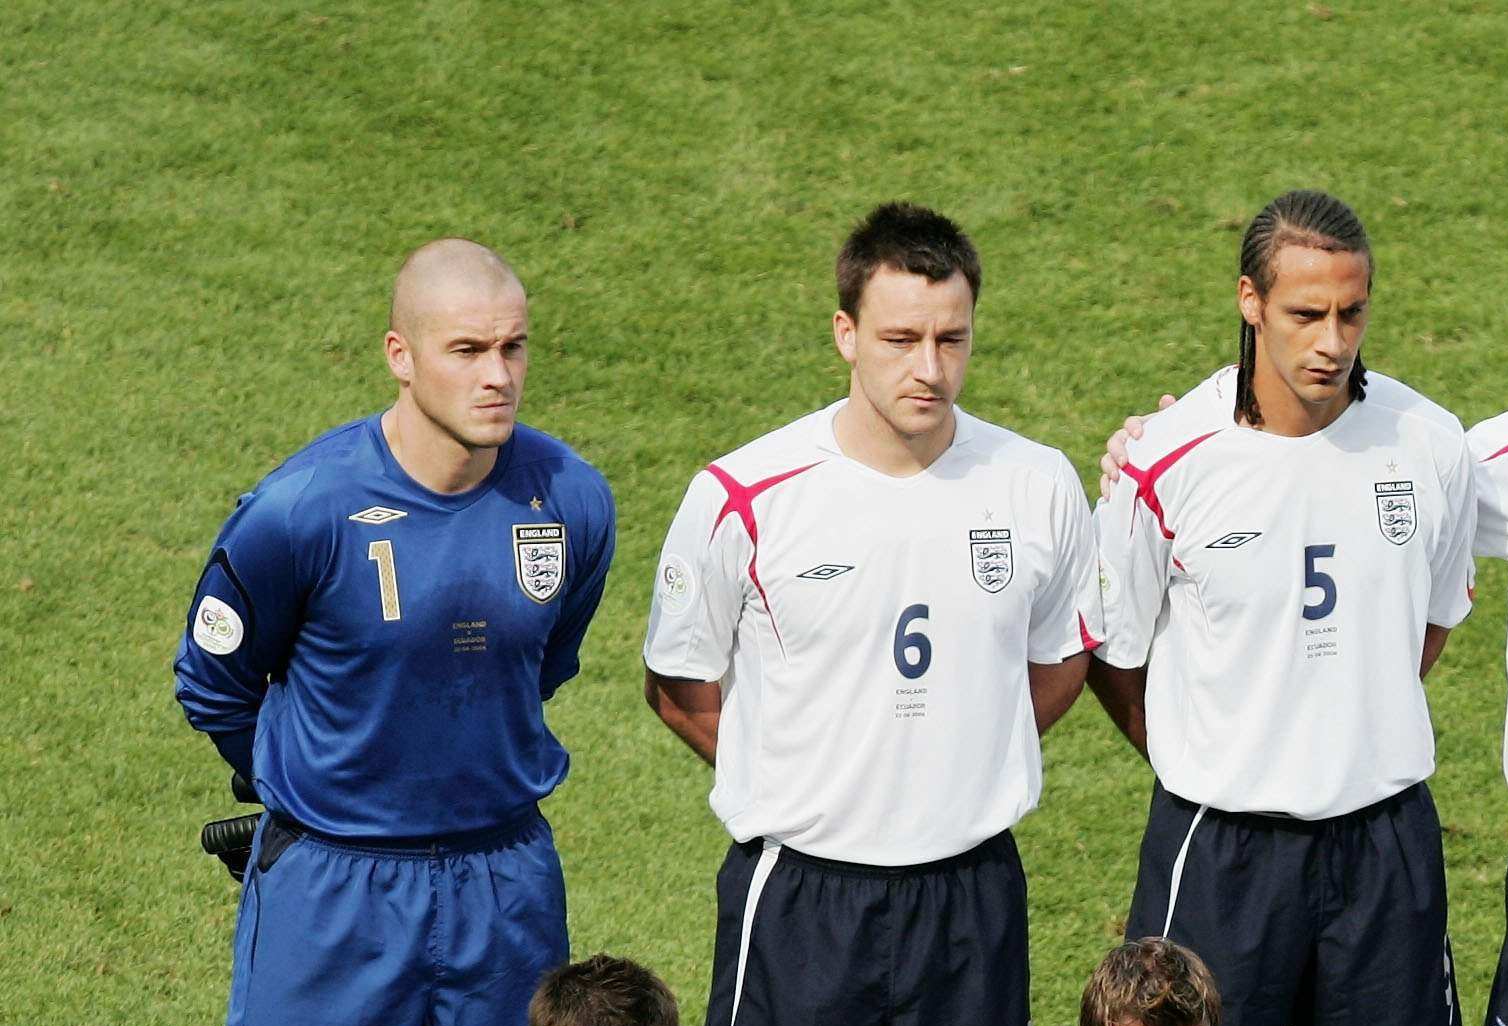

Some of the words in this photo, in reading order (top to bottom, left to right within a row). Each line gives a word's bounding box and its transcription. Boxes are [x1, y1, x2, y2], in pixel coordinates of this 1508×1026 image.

[519, 528, 560, 538] ENGLAND
[368, 539, 401, 621] 1
[1302, 544, 1337, 620] 5
[893, 603, 932, 679] 6
